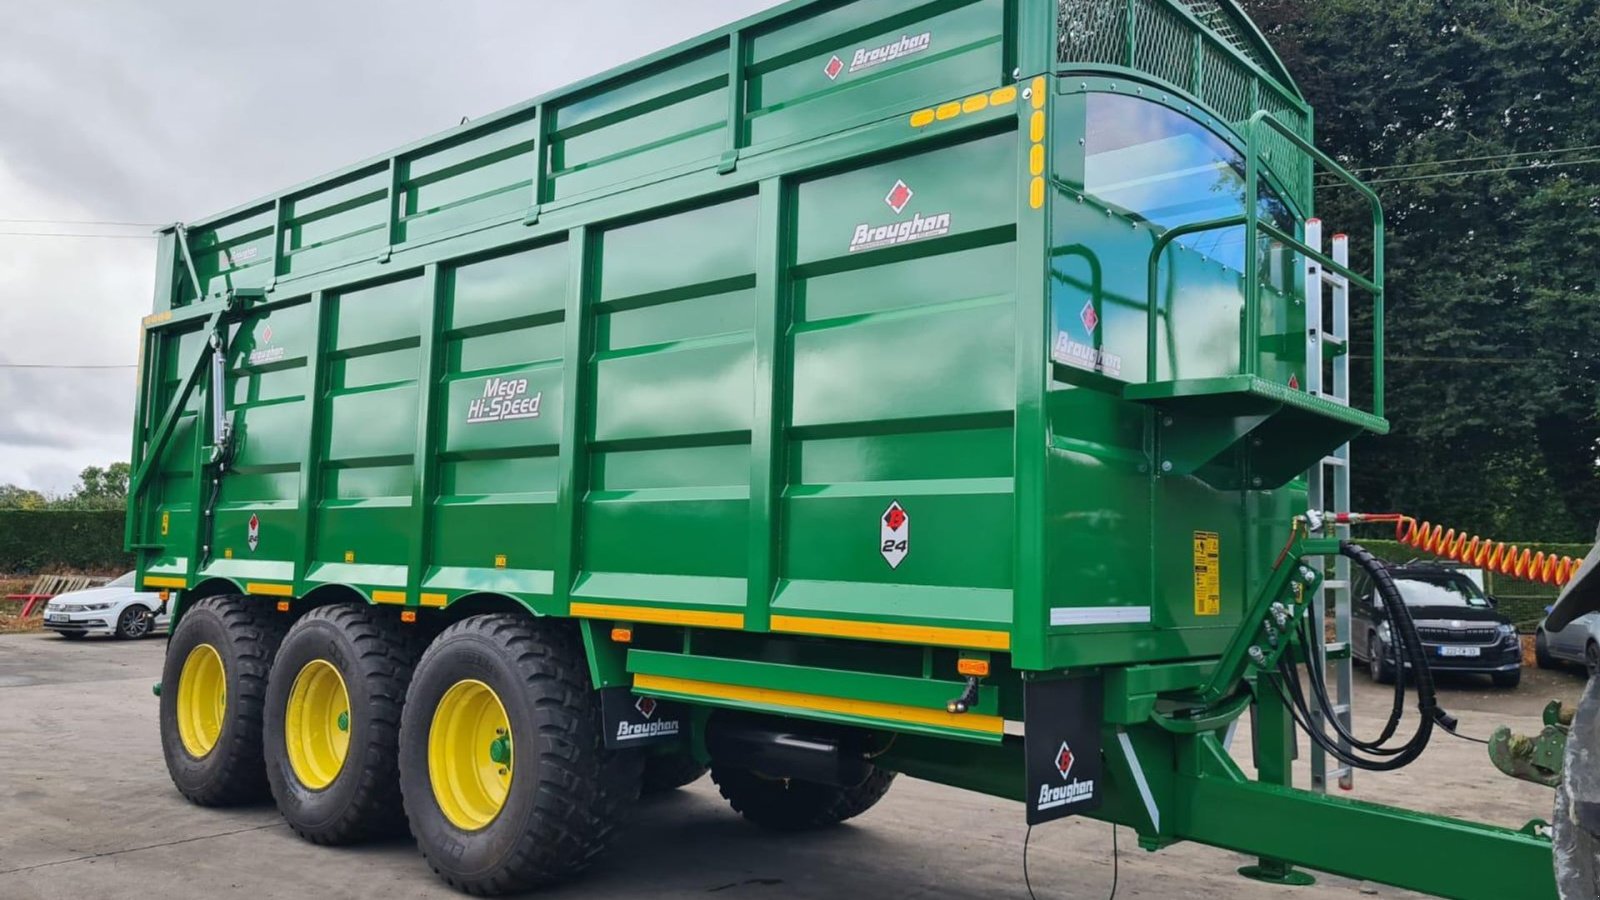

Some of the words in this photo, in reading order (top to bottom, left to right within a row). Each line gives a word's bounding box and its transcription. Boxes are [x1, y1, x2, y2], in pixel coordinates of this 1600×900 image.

[849, 32, 931, 72] Broughan
[850, 213, 950, 251] Broughan
[483, 378, 527, 399] Mega
[467, 392, 541, 421] Hi-Speed
[882, 539, 907, 553] 24
[616, 718, 679, 740] Broughan
[1037, 777, 1094, 811] Broughan
